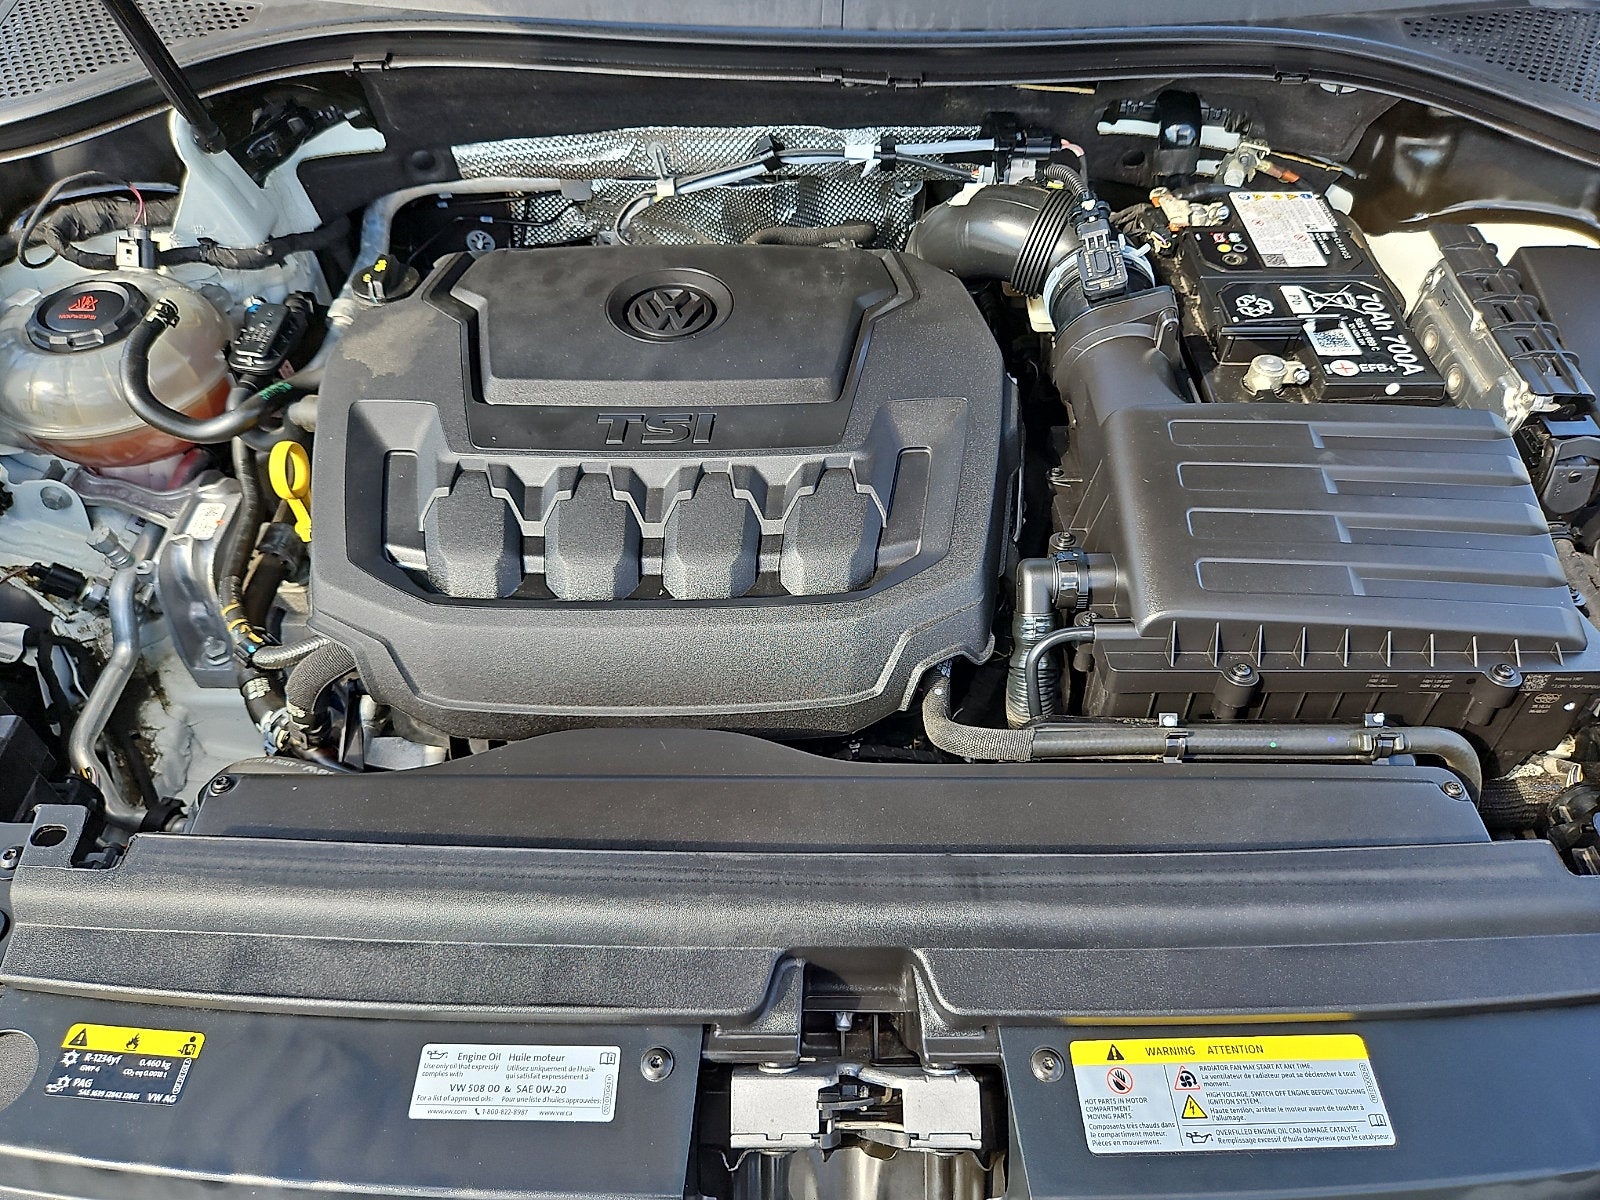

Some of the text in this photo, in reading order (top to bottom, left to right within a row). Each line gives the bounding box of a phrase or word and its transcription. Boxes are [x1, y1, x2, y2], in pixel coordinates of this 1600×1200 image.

[1356, 293, 1426, 376] 70Ah 700A
[1359, 363, 1397, 373] EFB+
[597, 412, 718, 445] TSI
[1145, 1045, 1264, 1056] WARNING ATTENTION
[83, 1053, 123, 1066] R-1234yf
[458, 1052, 501, 1062] Engine Oil
[509, 1053, 531, 1061] Huile
[161, 1060, 172, 1070] kg
[72, 1078, 93, 1088] PAG
[450, 1084, 467, 1092] VW
[468, 1084, 485, 1092] 508
[487, 1085, 500, 1093] 00
[516, 1085, 534, 1093] SAE
[536, 1085, 567, 1093] 0W-20
[147, 1093, 177, 1103] VW AG
[1089, 1123, 1125, 1131] Composants
[1218, 1137, 1256, 1145] Remplissage
[1303, 1135, 1336, 1143] dangereux
